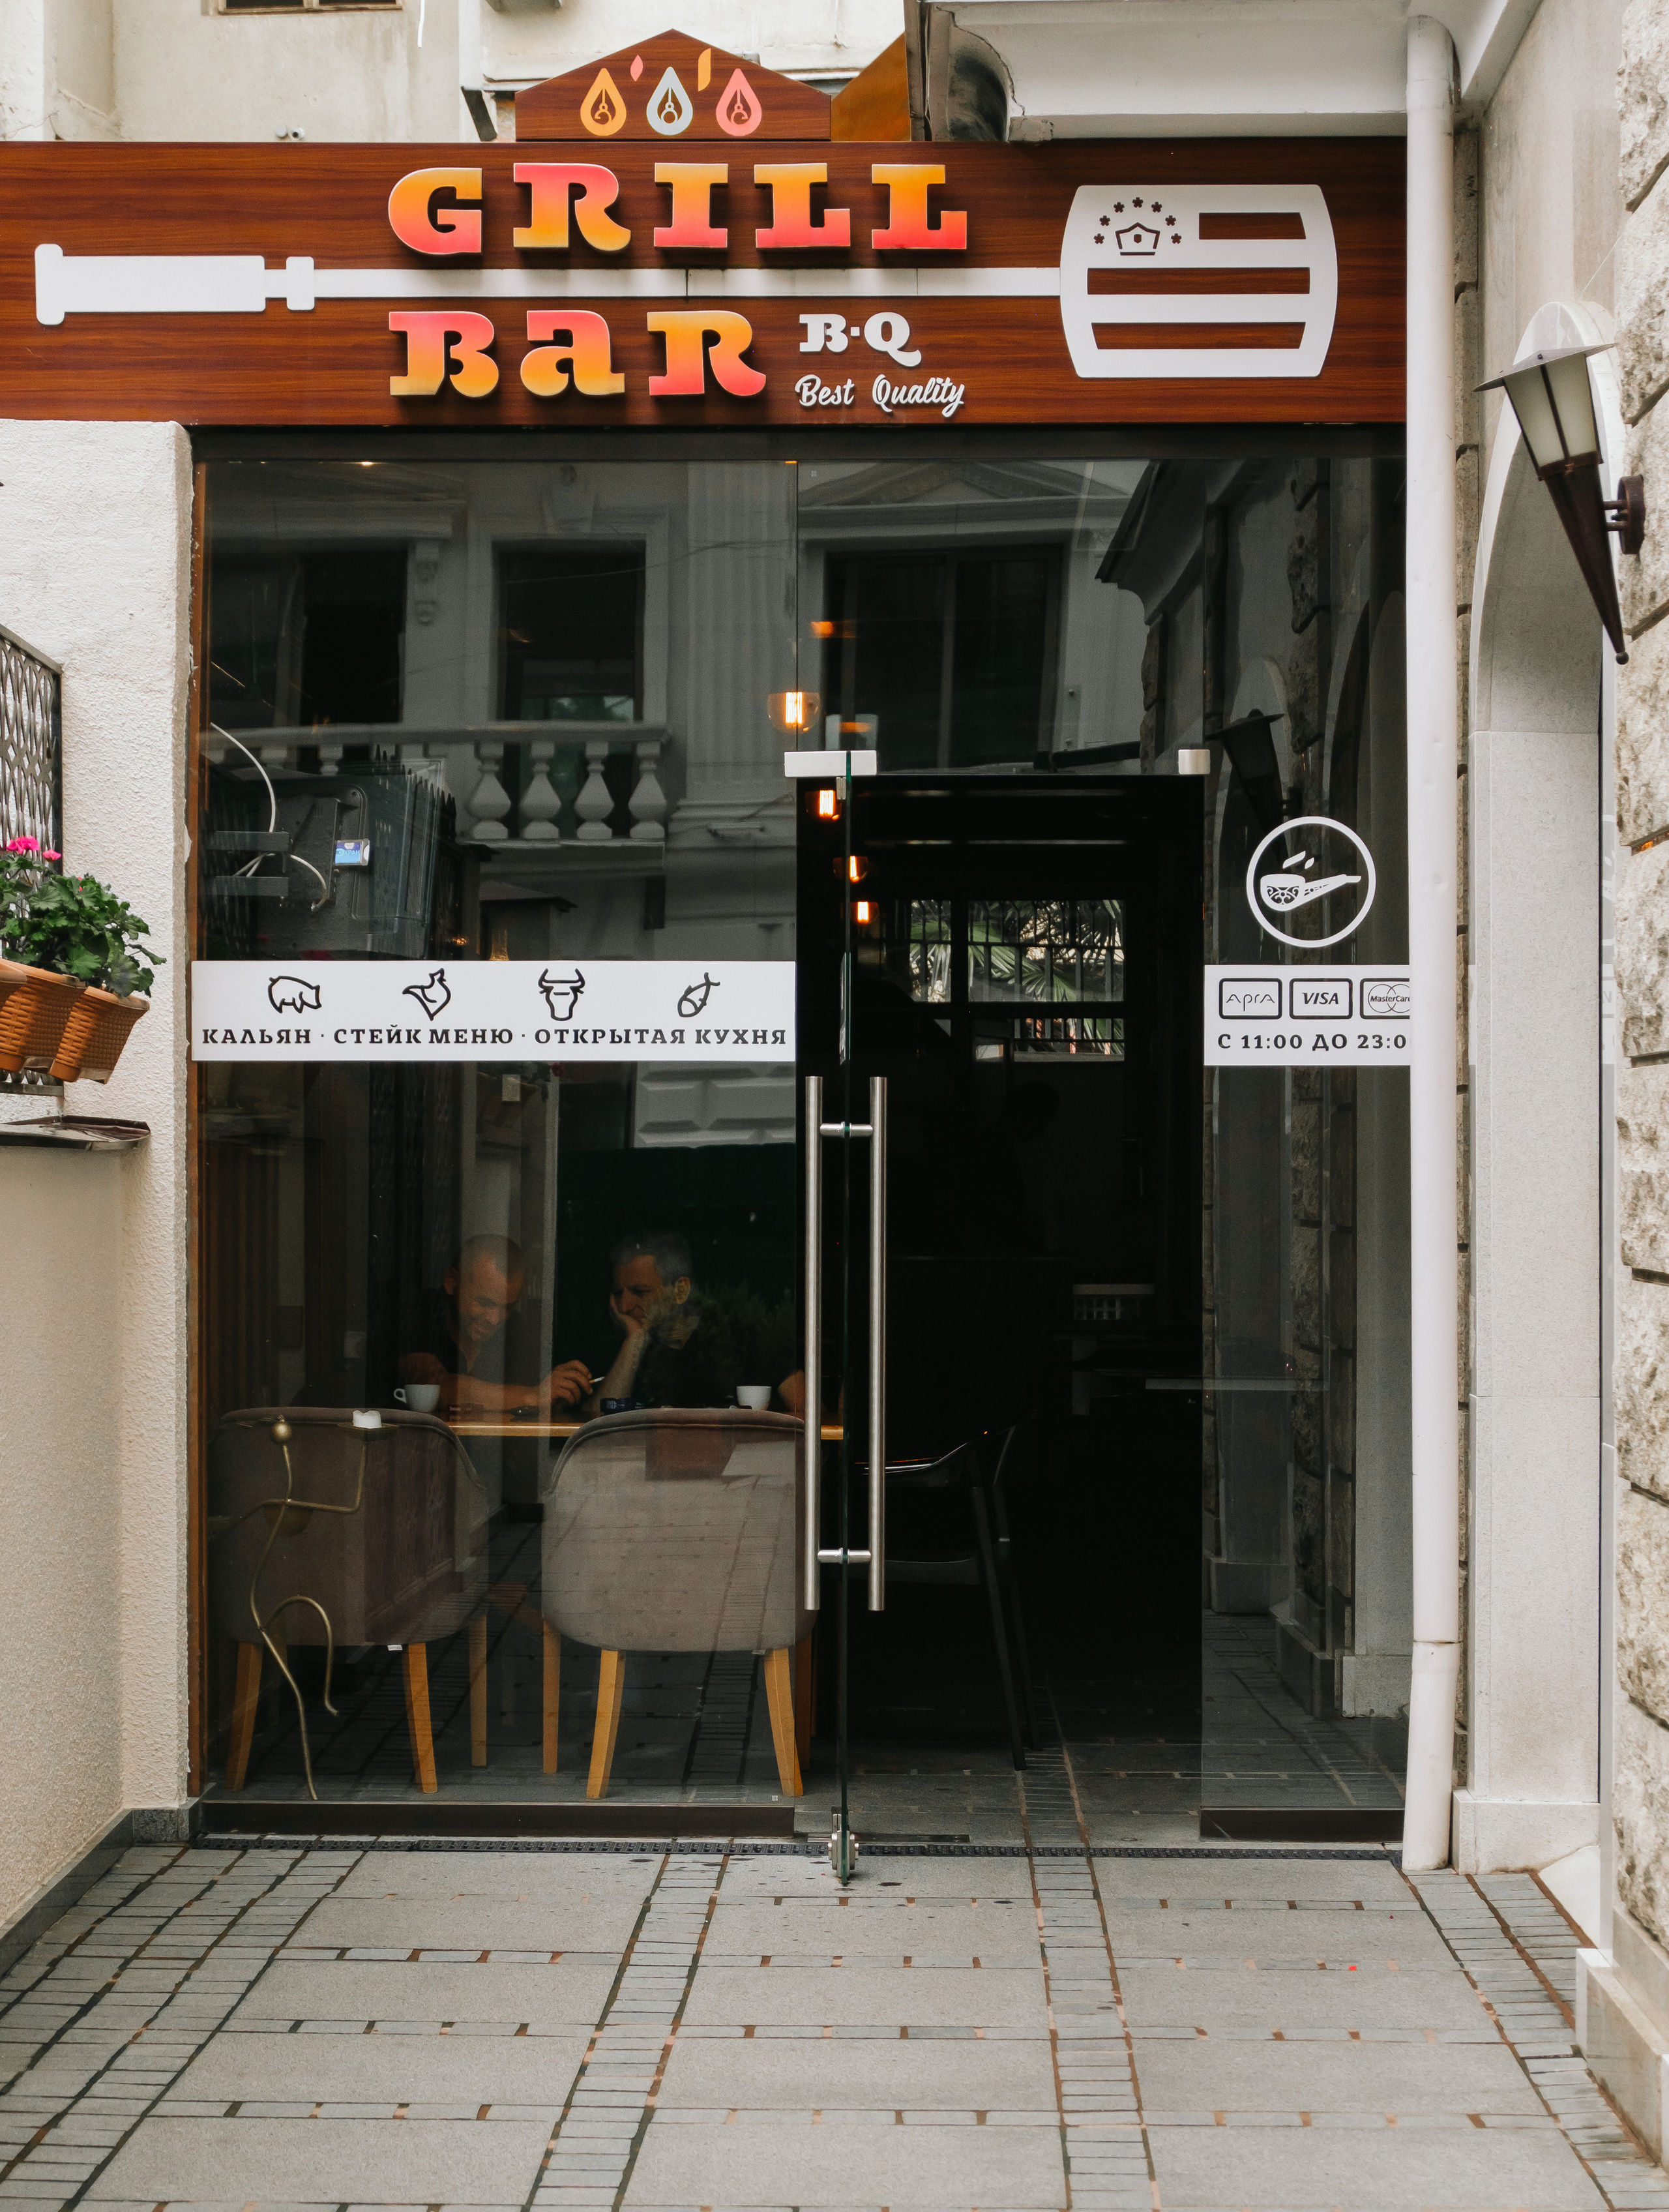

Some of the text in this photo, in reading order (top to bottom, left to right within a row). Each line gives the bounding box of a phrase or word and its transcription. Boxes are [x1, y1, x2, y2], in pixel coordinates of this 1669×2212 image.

[388, 162, 967, 256] GRILL
[794, 374, 965, 418] Best Quality
[1301, 991, 1340, 1005] VISA
[202, 1024, 786, 1045] КАЛЬЯН СТЕЙК МЕНЮ ОТКРЫТАЯ КУХНЯ
[1218, 1034, 1408, 1052] С 11:00 ДО 23:0
